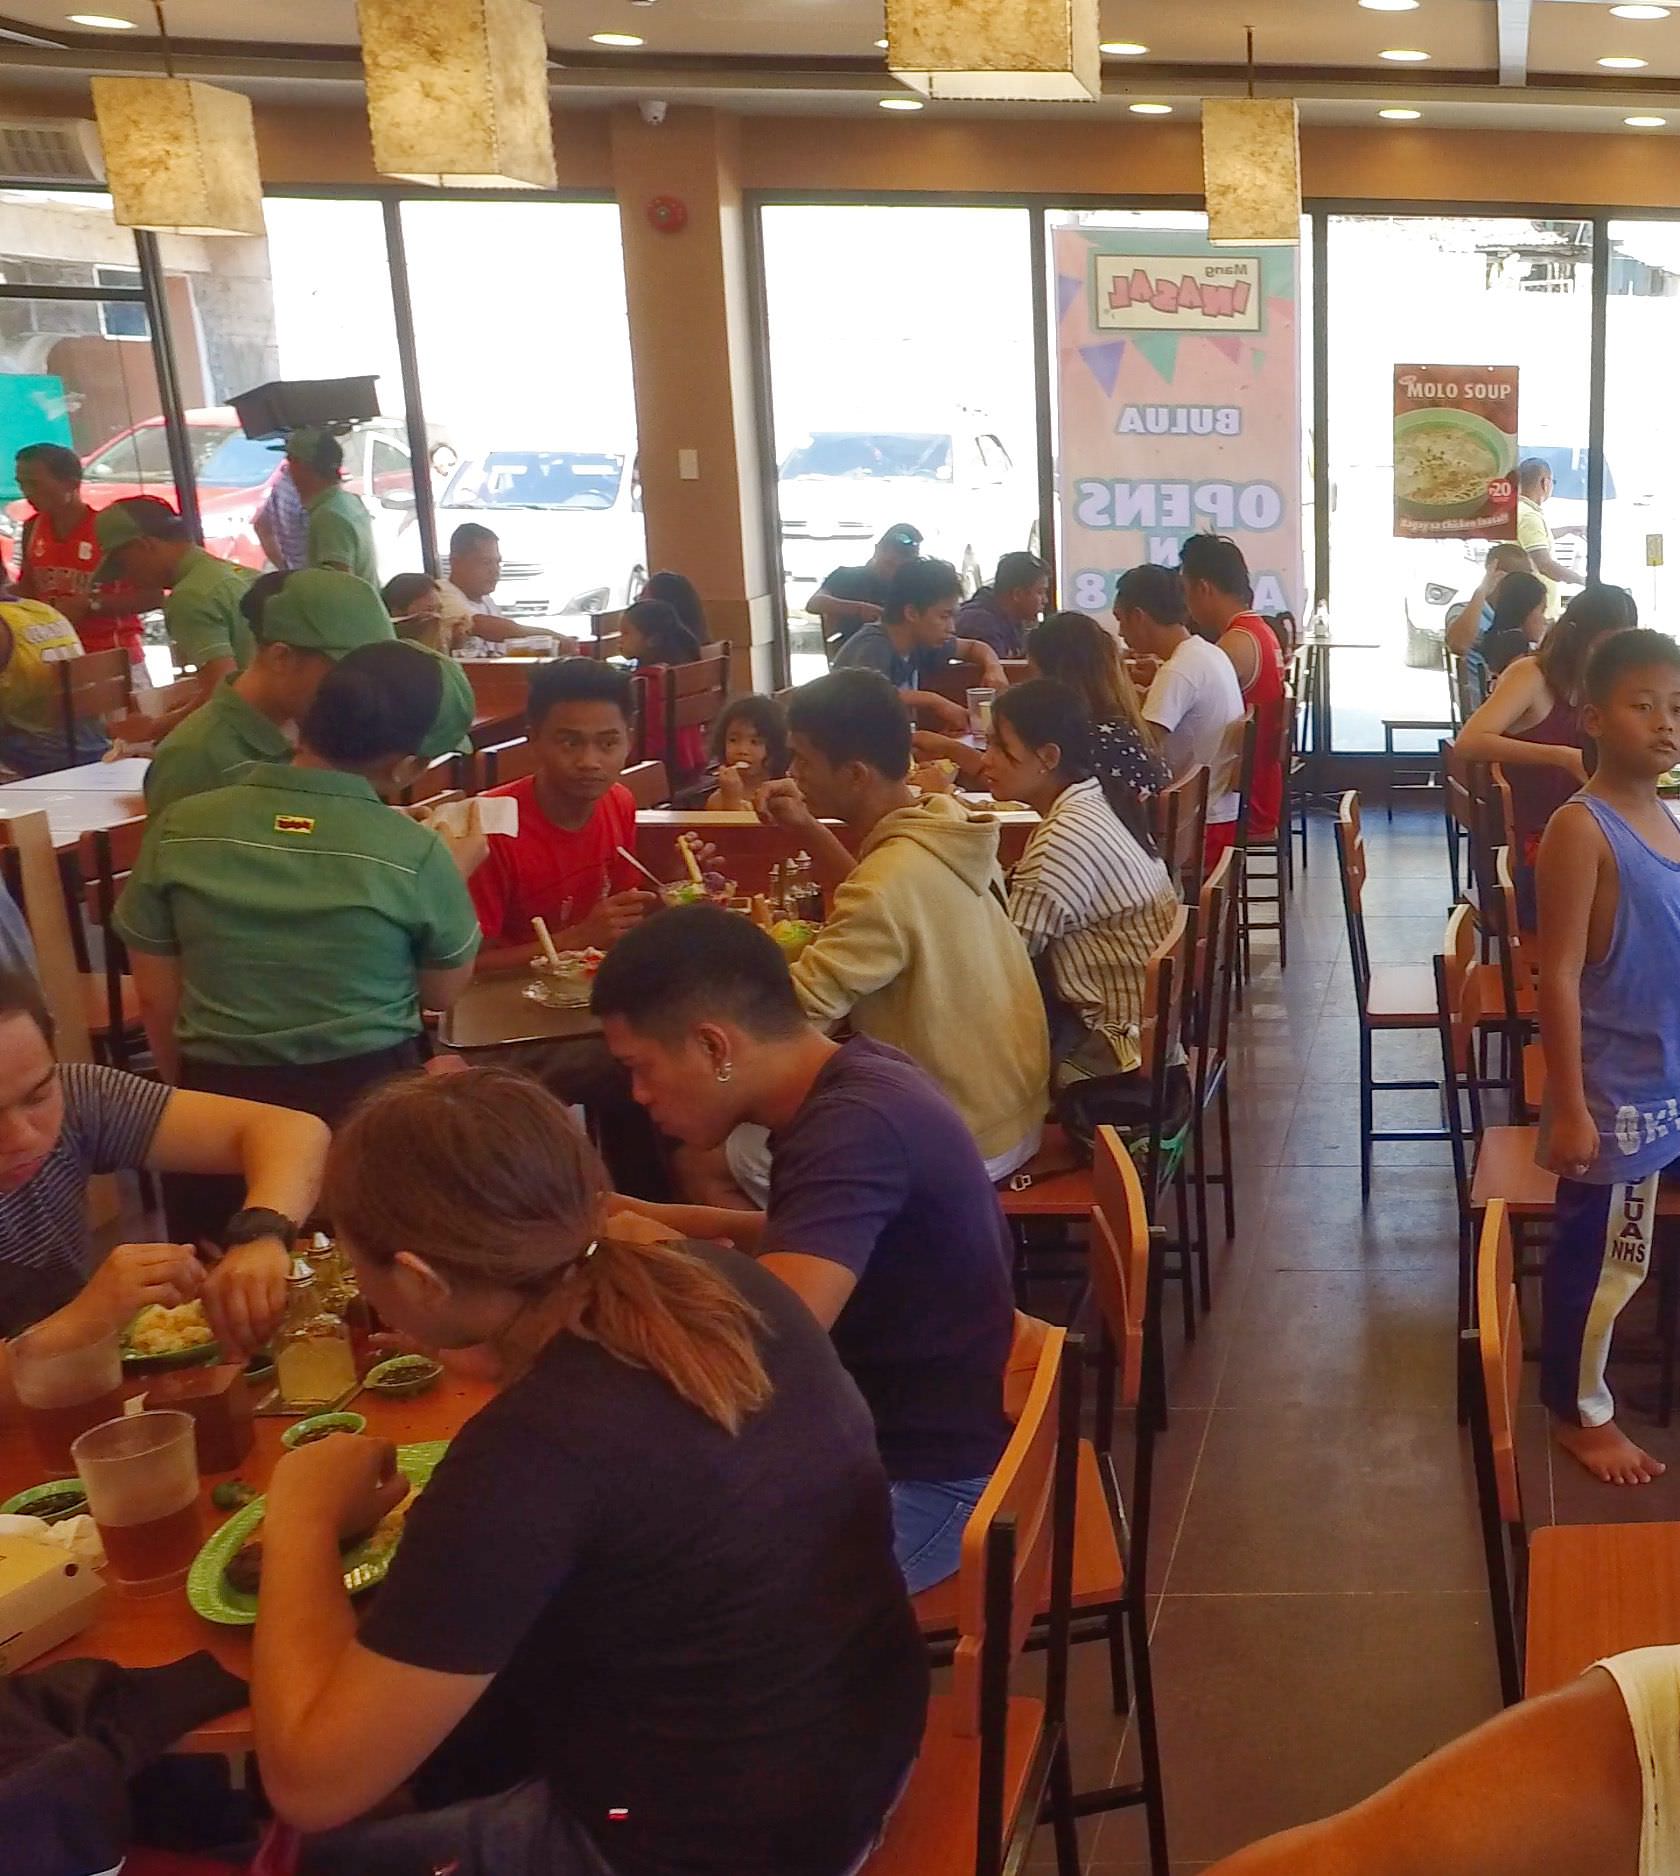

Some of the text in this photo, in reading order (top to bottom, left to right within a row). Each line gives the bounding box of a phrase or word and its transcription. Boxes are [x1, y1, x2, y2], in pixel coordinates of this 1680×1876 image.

[1407, 383, 1511, 399] MOLO SOUP
[1611, 1240, 1646, 1263] NHS
